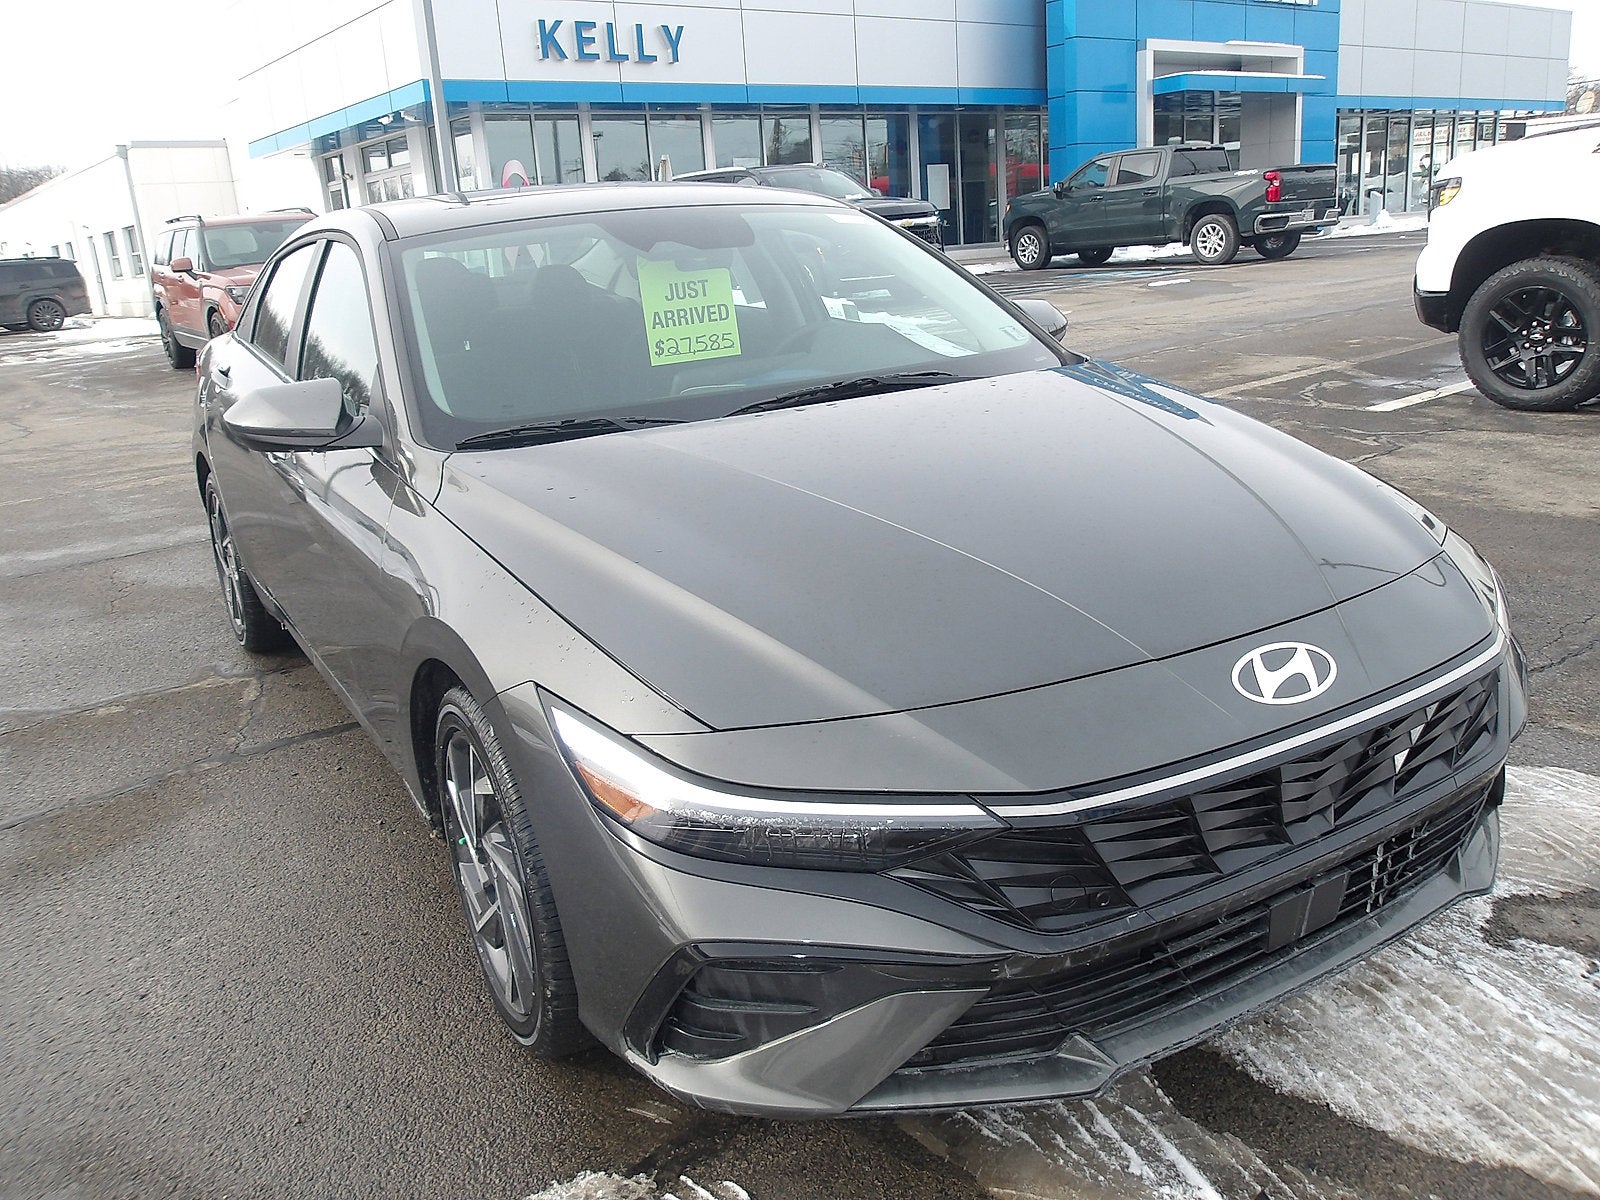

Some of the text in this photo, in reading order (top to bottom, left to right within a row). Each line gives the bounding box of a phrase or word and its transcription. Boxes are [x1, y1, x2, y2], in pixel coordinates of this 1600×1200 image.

[537, 19, 684, 63] KELLY
[664, 279, 709, 302] JUST
[652, 303, 730, 330] ARRIVED
